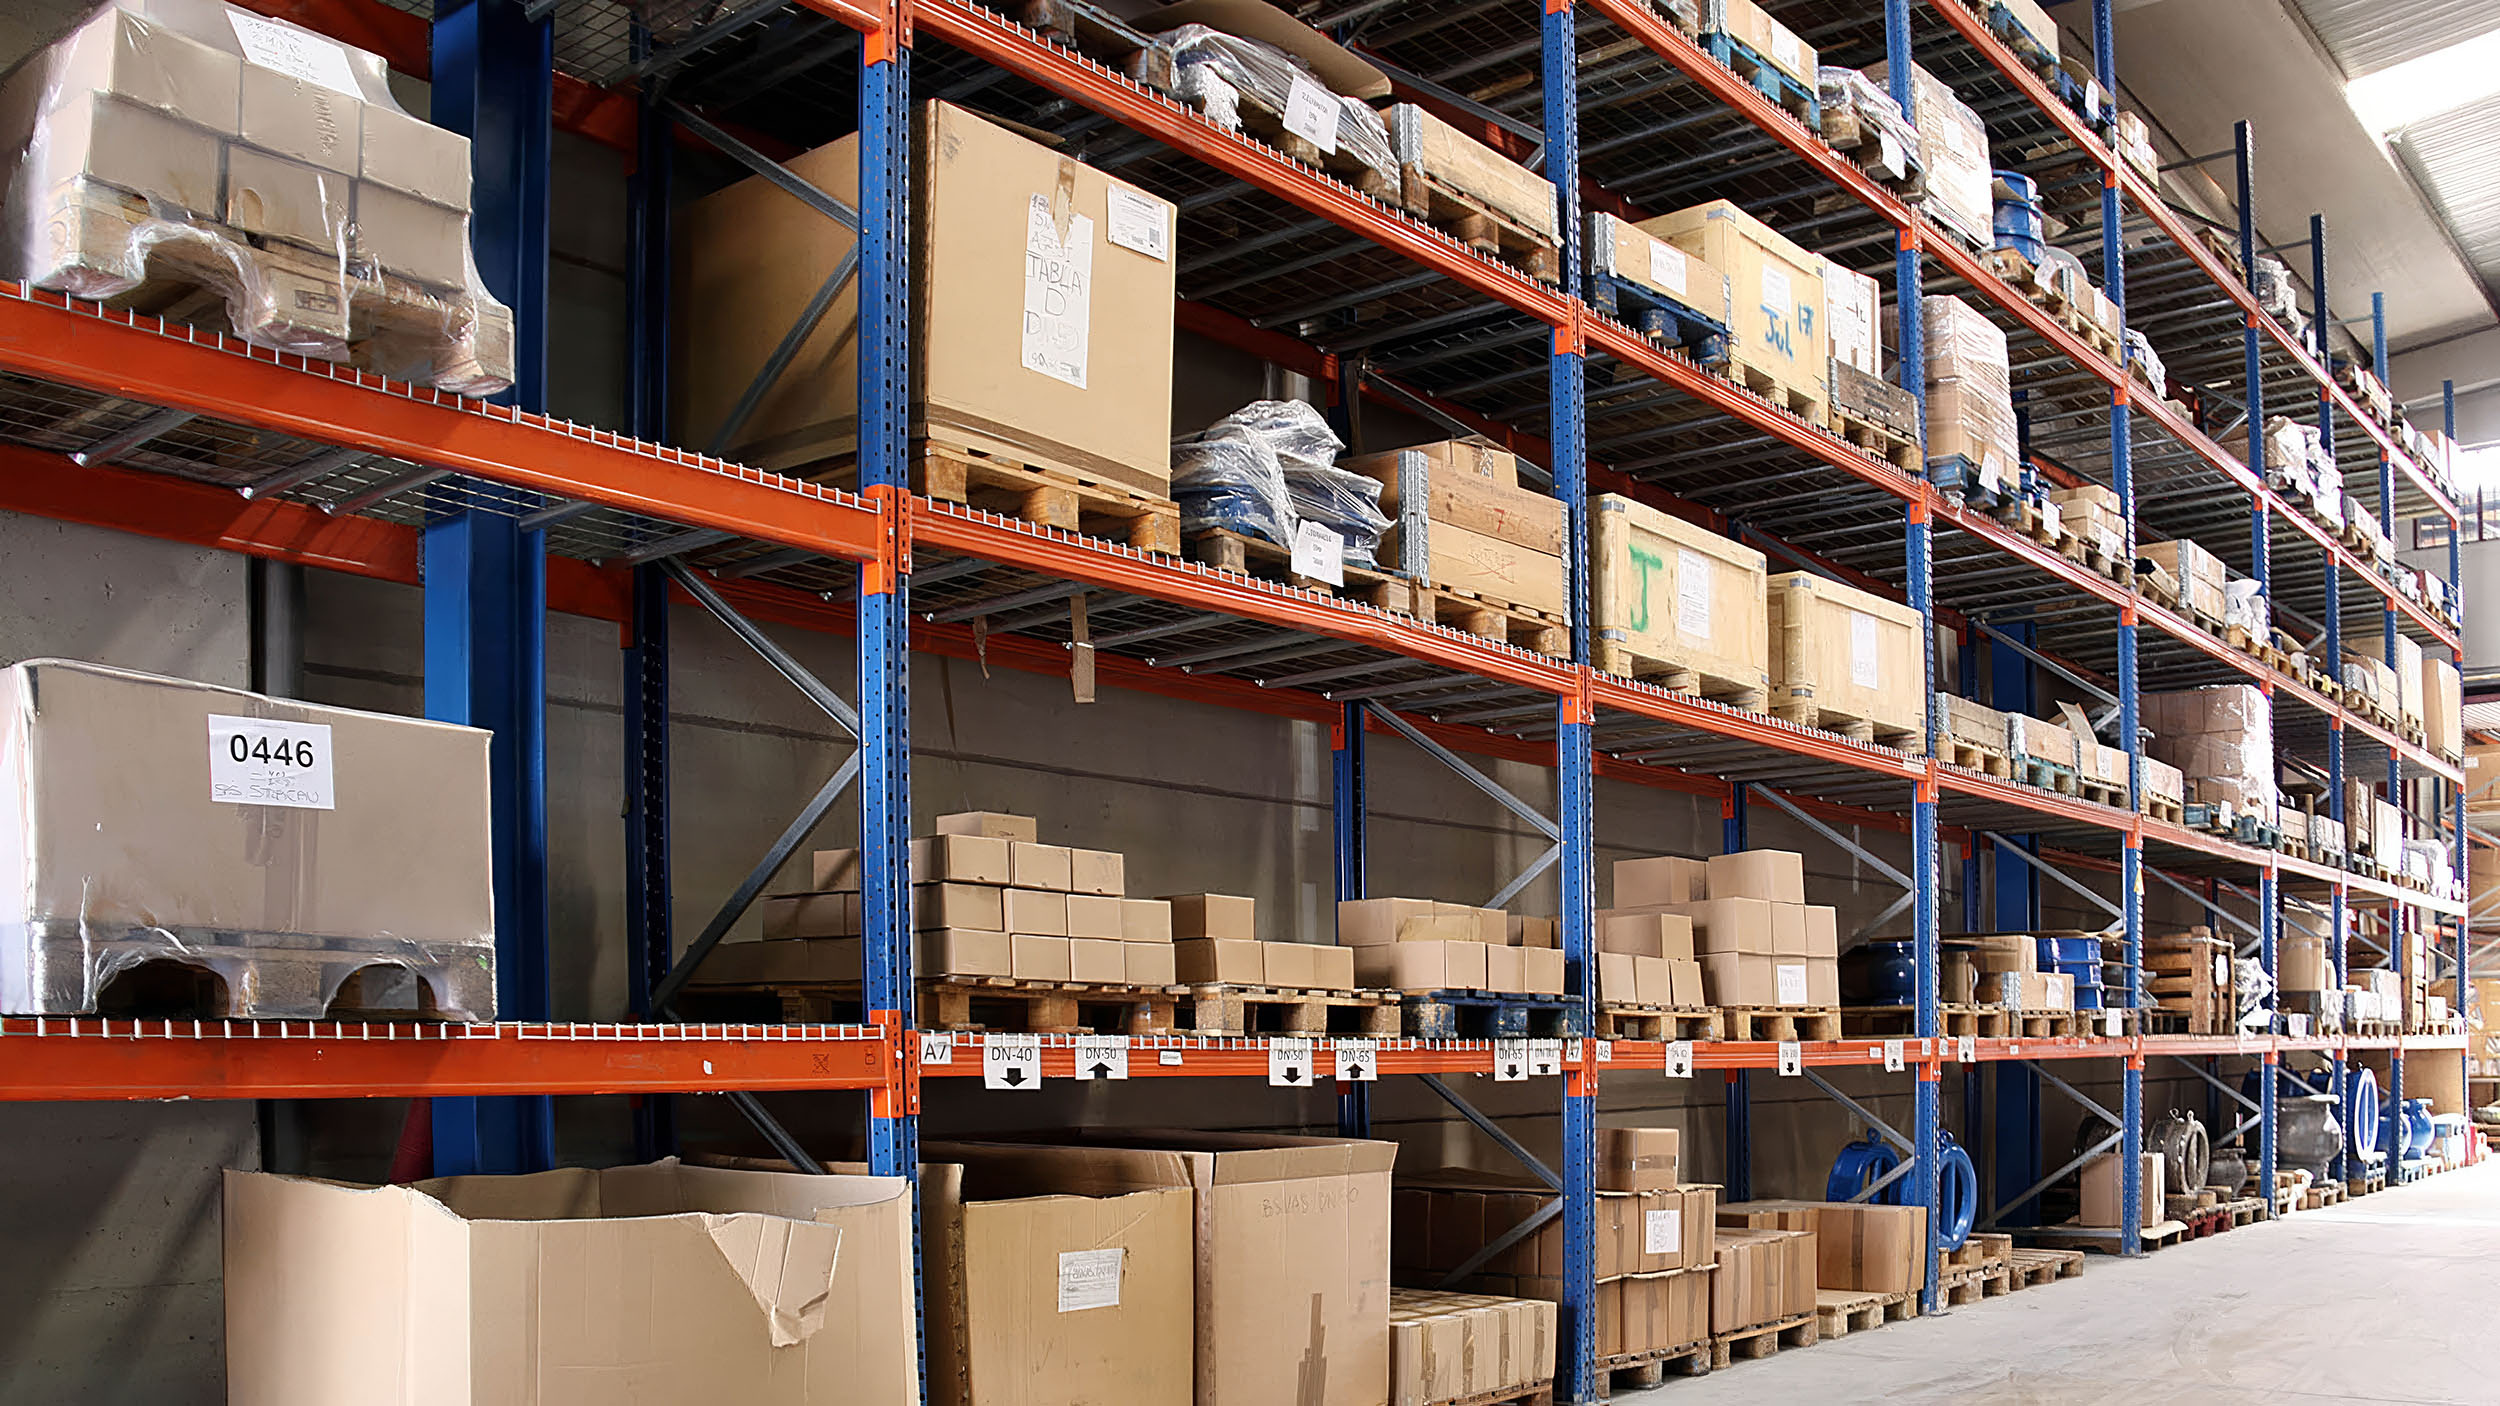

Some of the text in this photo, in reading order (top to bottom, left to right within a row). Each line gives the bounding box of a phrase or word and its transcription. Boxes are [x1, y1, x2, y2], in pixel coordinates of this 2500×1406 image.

[229, 734, 314, 768] 0446
[924, 1042, 947, 1061] A7
[991, 1047, 1033, 1062] DN-40
[1277, 1049, 1304, 1061] DN-50
[1341, 1050, 1370, 1063] DN-65
